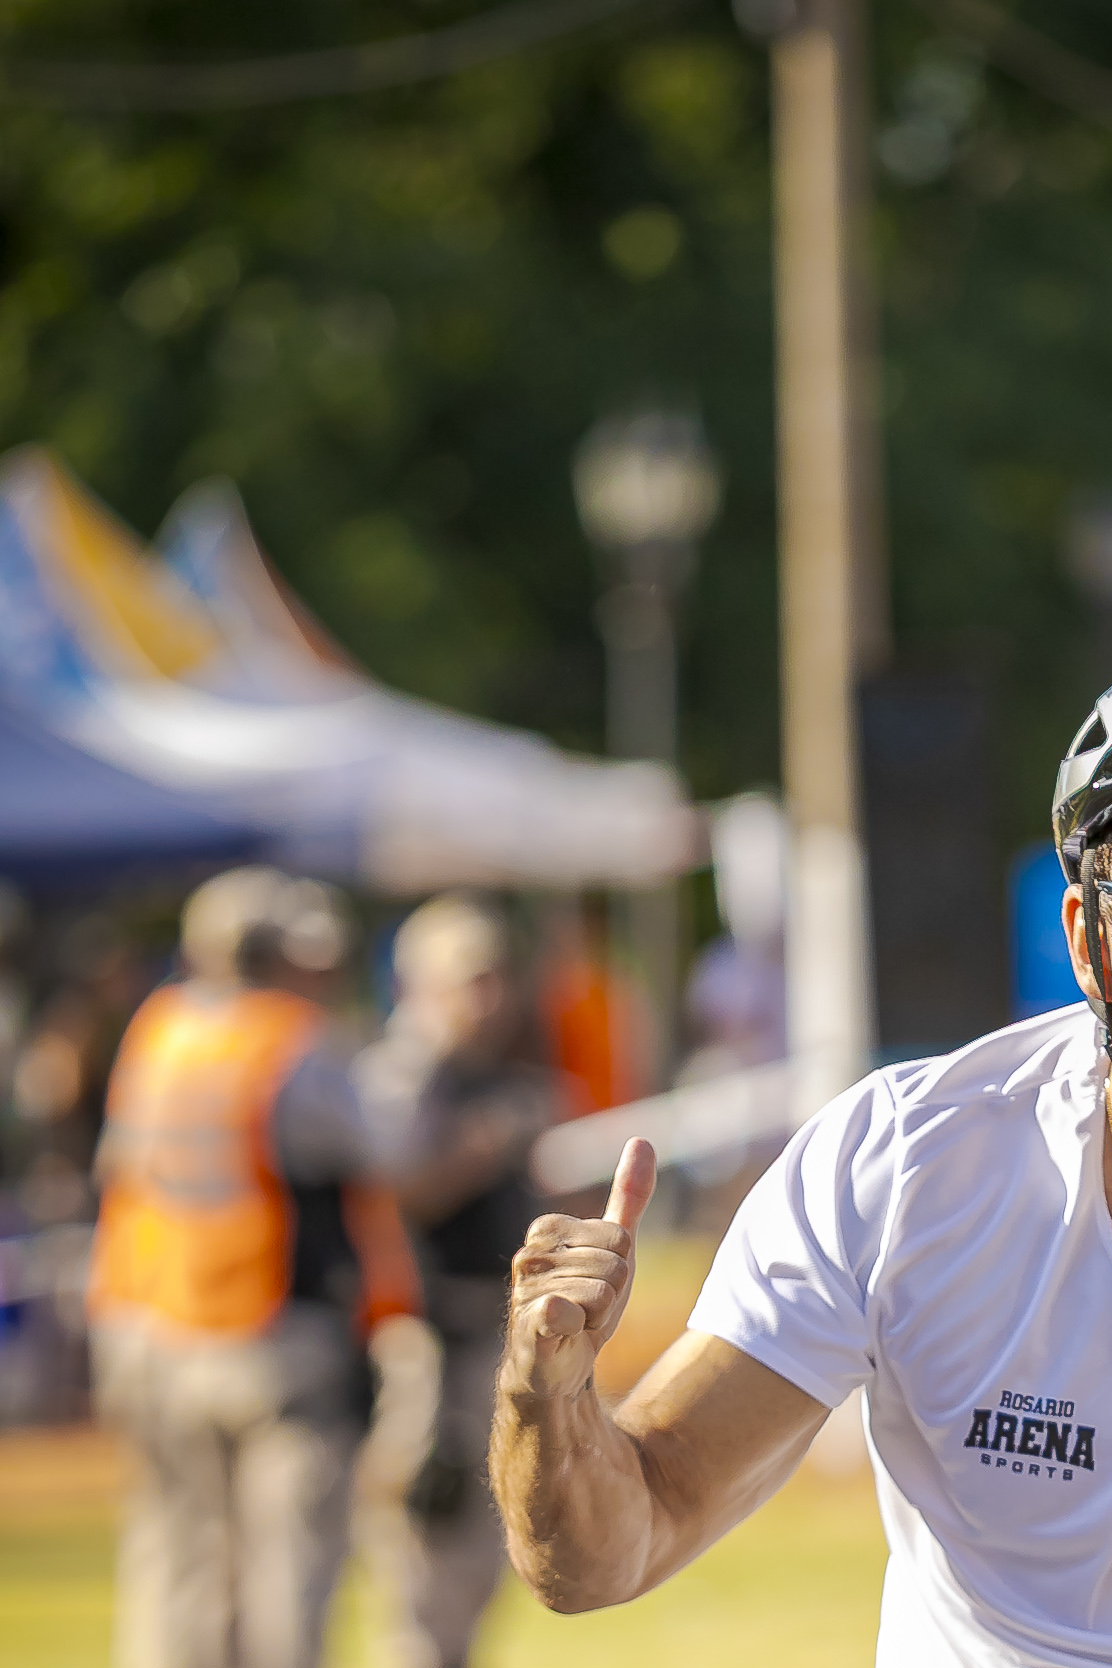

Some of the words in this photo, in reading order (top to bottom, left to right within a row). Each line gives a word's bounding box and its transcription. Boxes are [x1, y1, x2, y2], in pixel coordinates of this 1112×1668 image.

[1000, 1390, 1075, 1418] ROSARIO
[964, 1408, 1095, 1471] ARENA
[980, 1453, 1073, 1480] SPORTS
